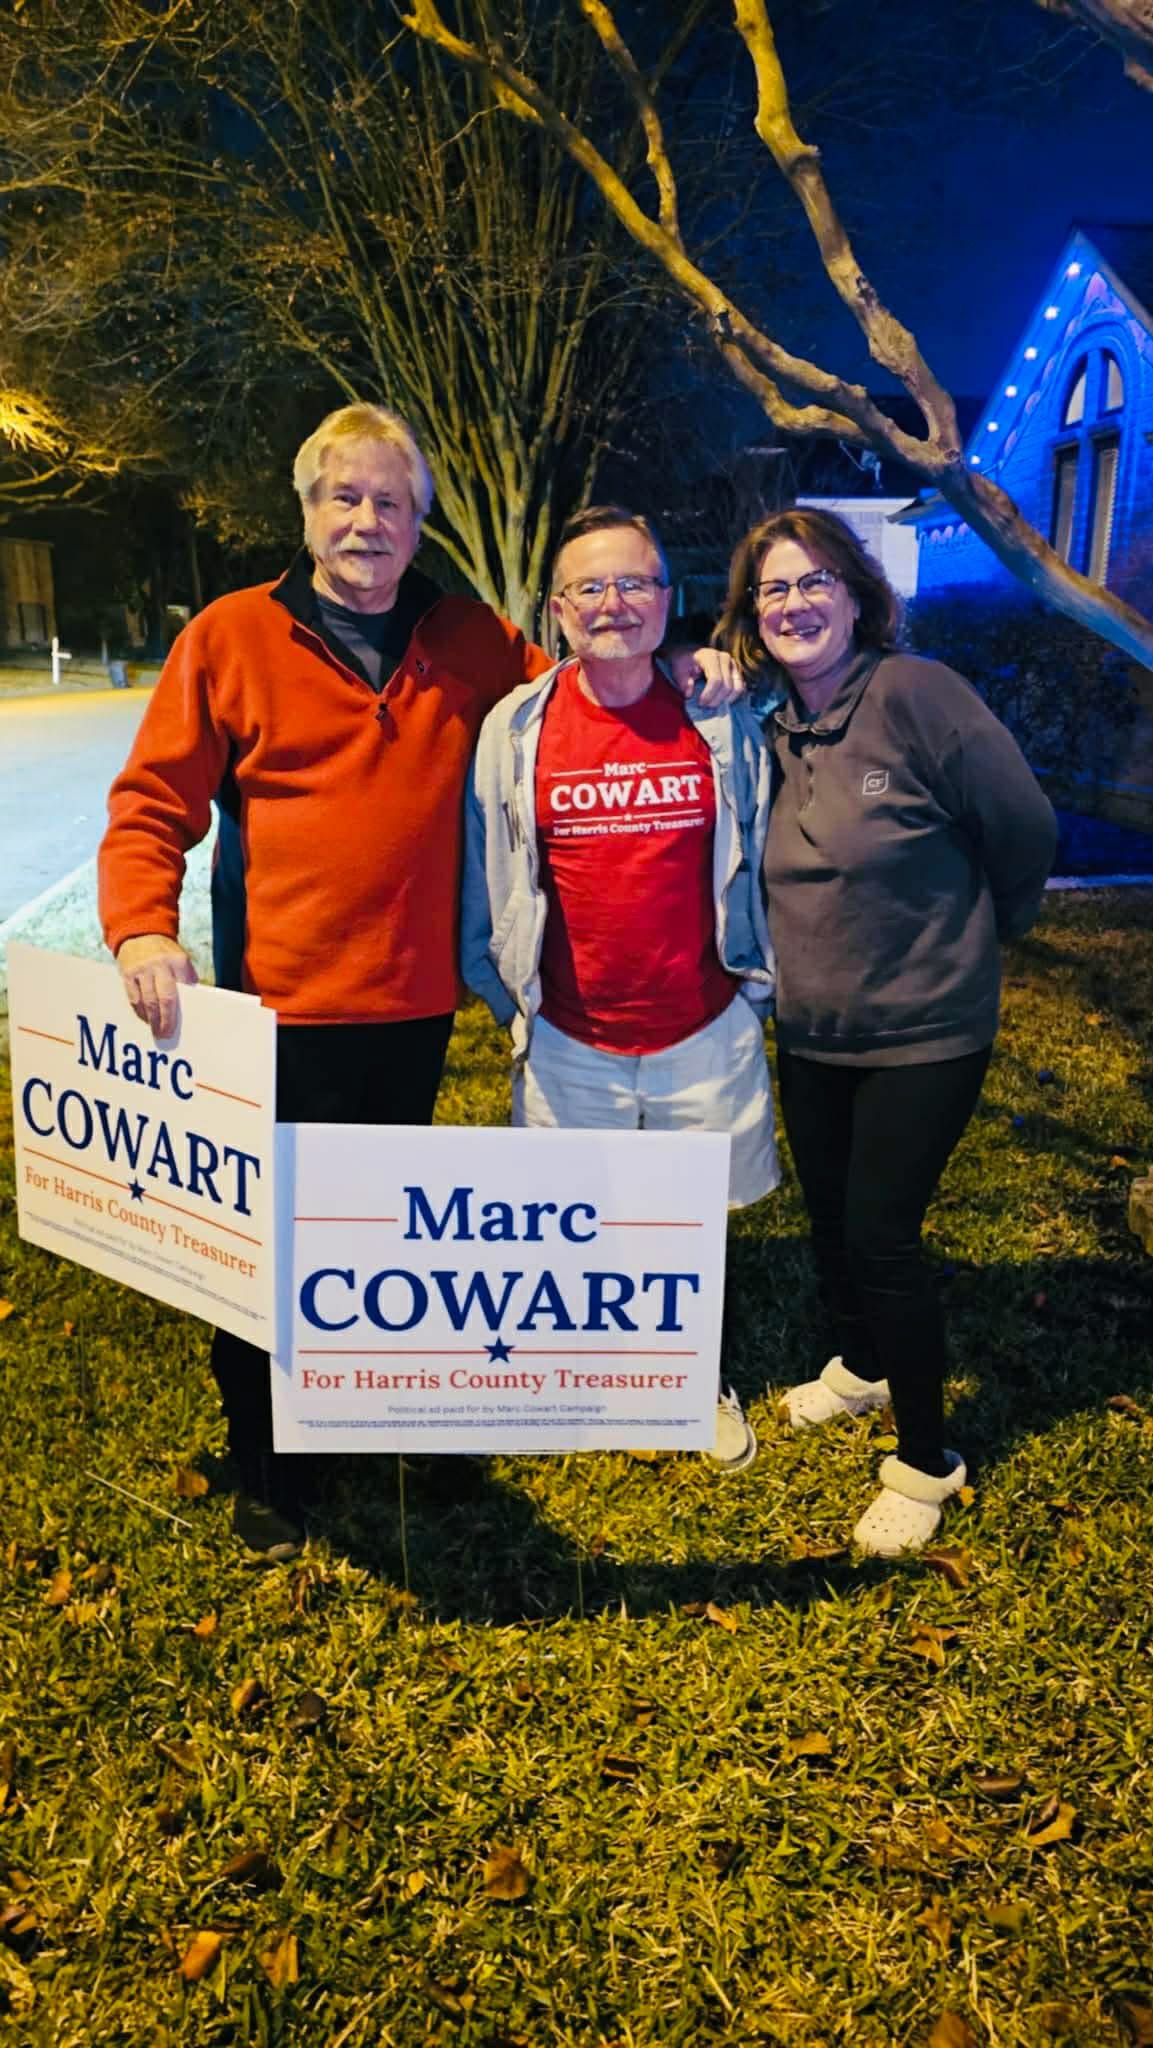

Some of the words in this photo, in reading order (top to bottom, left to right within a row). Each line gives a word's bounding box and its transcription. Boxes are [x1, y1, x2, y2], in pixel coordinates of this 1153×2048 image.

[603, 761, 647, 777] Marc
[550, 774, 701, 812] COWART
[572, 823, 608, 836] Harris
[609, 822, 651, 834] County
[652, 817, 705, 831] Treasurer
[76, 1014, 194, 1100] Marc
[22, 1077, 261, 1216] COWART
[24, 1165, 49, 1190] For
[53, 1175, 103, 1213] Harris
[107, 1199, 167, 1244] County
[170, 1223, 257, 1279] Treasurer
[403, 1186, 598, 1243] Marc
[299, 1268, 700, 1332] COWART
[301, 1369, 345, 1390] For
[353, 1368, 441, 1390] Harris
[449, 1369, 547, 1395] County
[554, 1369, 689, 1390] Treasurer
[428, 1405, 441, 1414] ad
[442, 1405, 465, 1415] paid
[466, 1404, 480, 1414] for
[481, 1404, 495, 1415] by
[496, 1404, 521, 1413] Marc
[523, 1404, 557, 1413] Cowart
[559, 1404, 607, 1415] Campaign
